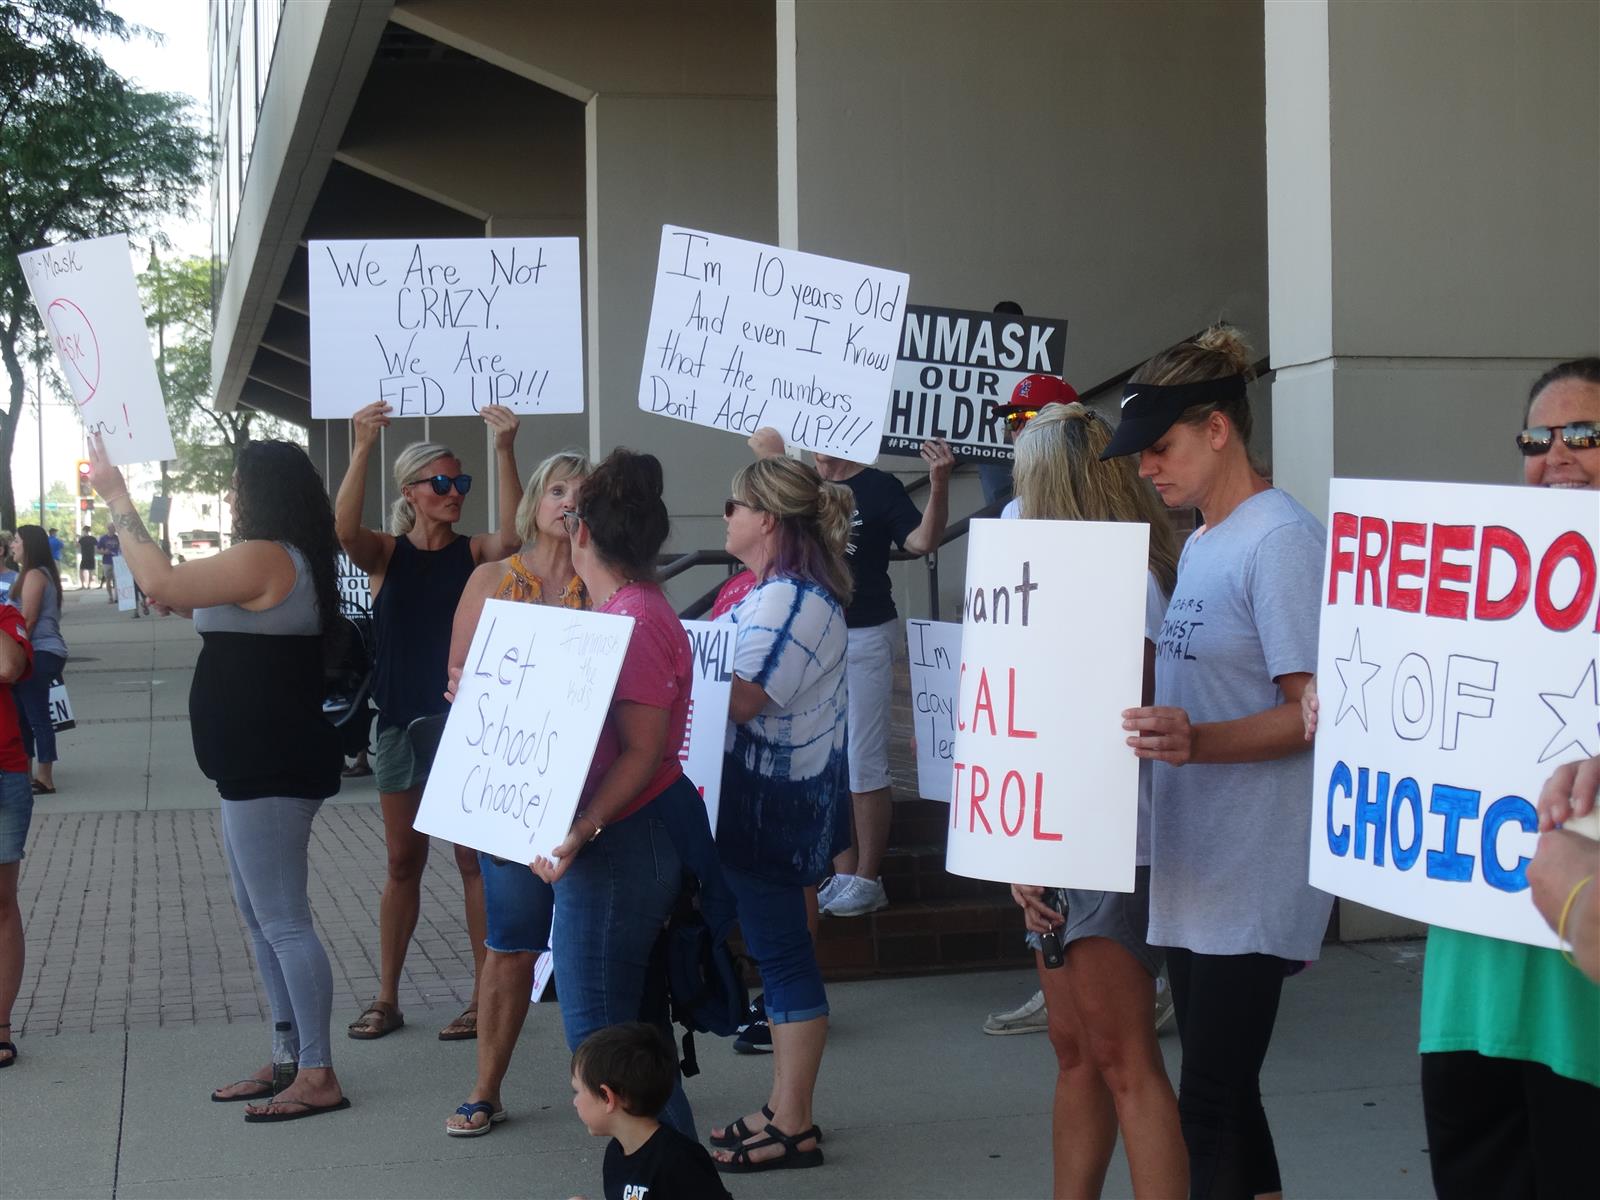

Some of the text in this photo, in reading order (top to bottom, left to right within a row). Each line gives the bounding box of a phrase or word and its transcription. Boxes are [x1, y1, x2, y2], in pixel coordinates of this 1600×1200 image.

[326, 243, 548, 287] We Are Not
[665, 232, 902, 322] I'm 10 years Old
[397, 285, 500, 330] CRAZY.
[686, 290, 730, 335] And
[742, 320, 786, 347] even
[795, 315, 831, 355] I
[374, 331, 506, 375] We Are
[657, 329, 853, 413] that the numbers
[902, 312, 1056, 373] NMASK
[379, 375, 445, 416] FED
[471, 370, 549, 413] UP!!!
[649, 375, 698, 421] Don't
[713, 391, 768, 434] Add
[919, 366, 1000, 396] OUR
[889, 389, 1014, 446] HILDR
[888, 438, 1016, 460] #PasChoice
[347, 578, 371, 591] OU
[1327, 511, 1600, 634] FREEDO
[474, 616, 536, 700] Let
[1157, 640, 1197, 661] NTRAL
[957, 662, 1038, 739] CAL
[1391, 652, 1499, 751] OF
[465, 692, 558, 775] Schools
[461, 764, 552, 844] Choose!
[954, 762, 1063, 842] TROL
[1326, 759, 1540, 894] CHOIC
[623, 1184, 649, 1200] CAT
